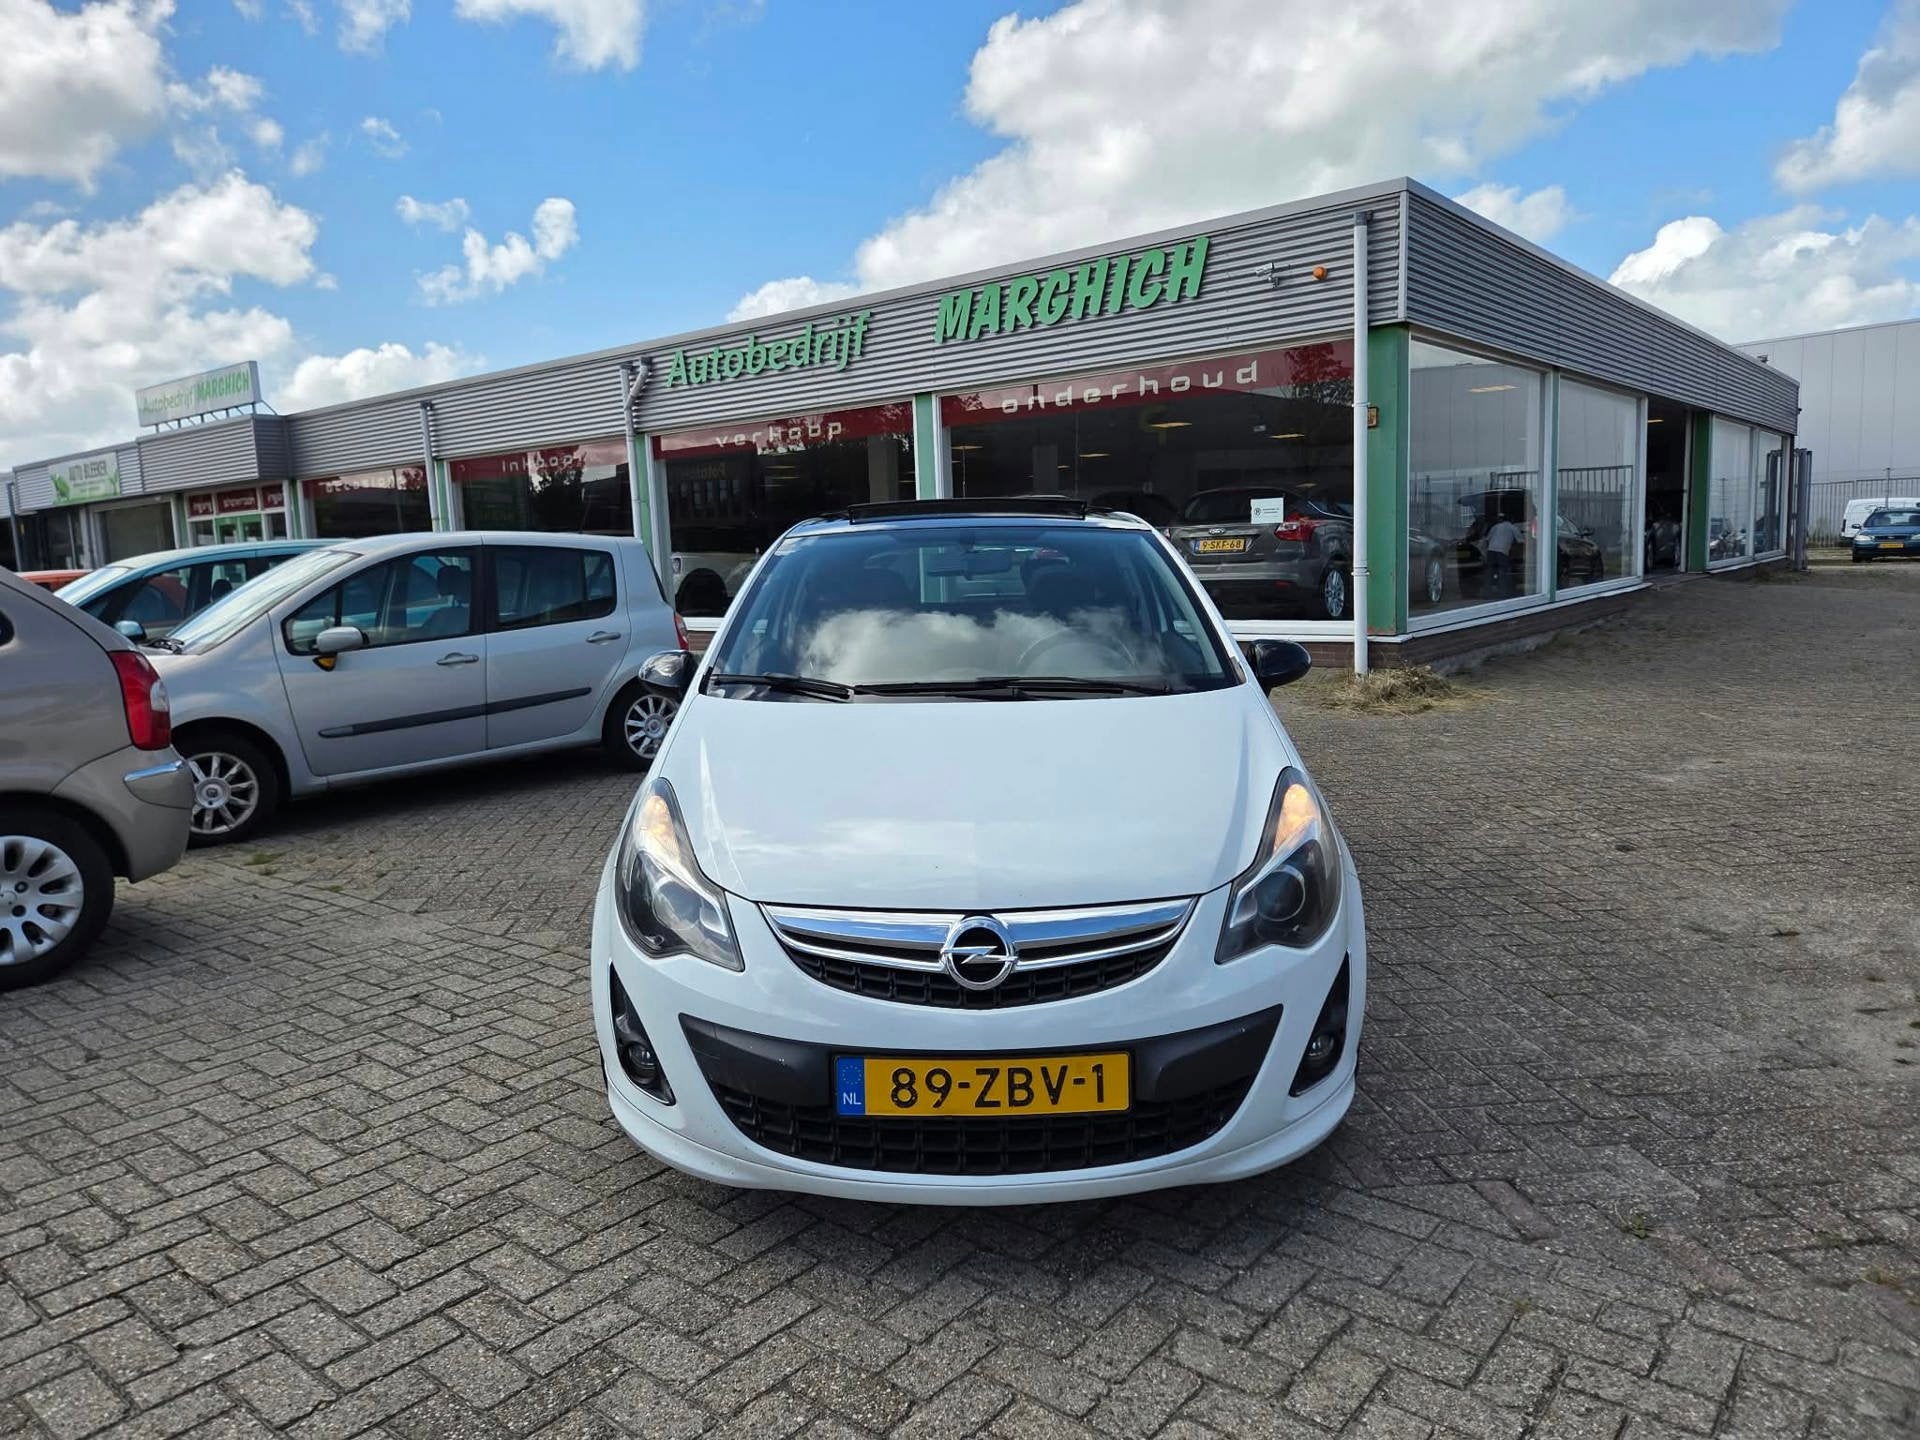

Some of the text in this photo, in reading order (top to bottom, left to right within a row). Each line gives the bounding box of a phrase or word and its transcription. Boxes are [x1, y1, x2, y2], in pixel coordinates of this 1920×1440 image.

[666, 236, 1210, 388] Autobedrijf MARGHICH
[1001, 360, 1258, 414] onderhoud
[716, 421, 843, 448] verkoop
[1202, 541, 1241, 550] 9-SKF-68
[842, 1062, 1105, 1109] NL 89-ZBV-1
